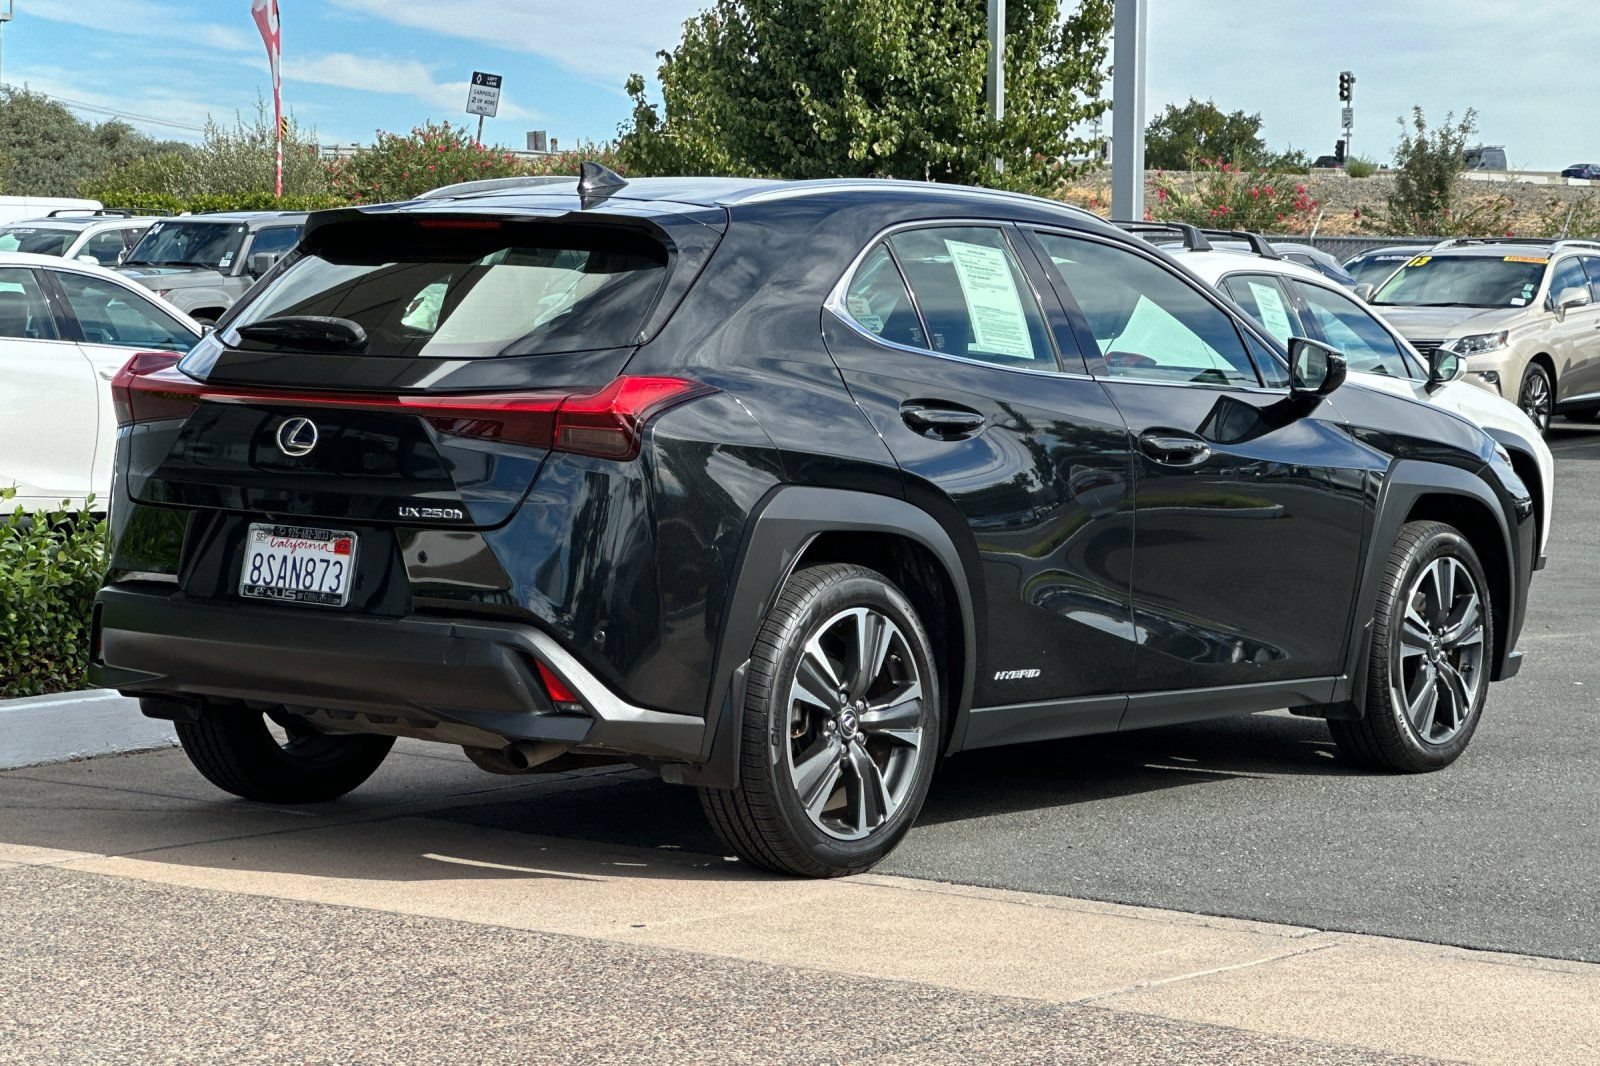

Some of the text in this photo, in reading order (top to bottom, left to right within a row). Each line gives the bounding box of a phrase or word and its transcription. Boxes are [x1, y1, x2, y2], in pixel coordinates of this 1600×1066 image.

[255, 532, 268, 542] SEP
[270, 537, 332, 554] California
[250, 552, 343, 593] 8SAN873
[244, 585, 297, 600] LEXUS
[993, 668, 1041, 681] HYBRID
